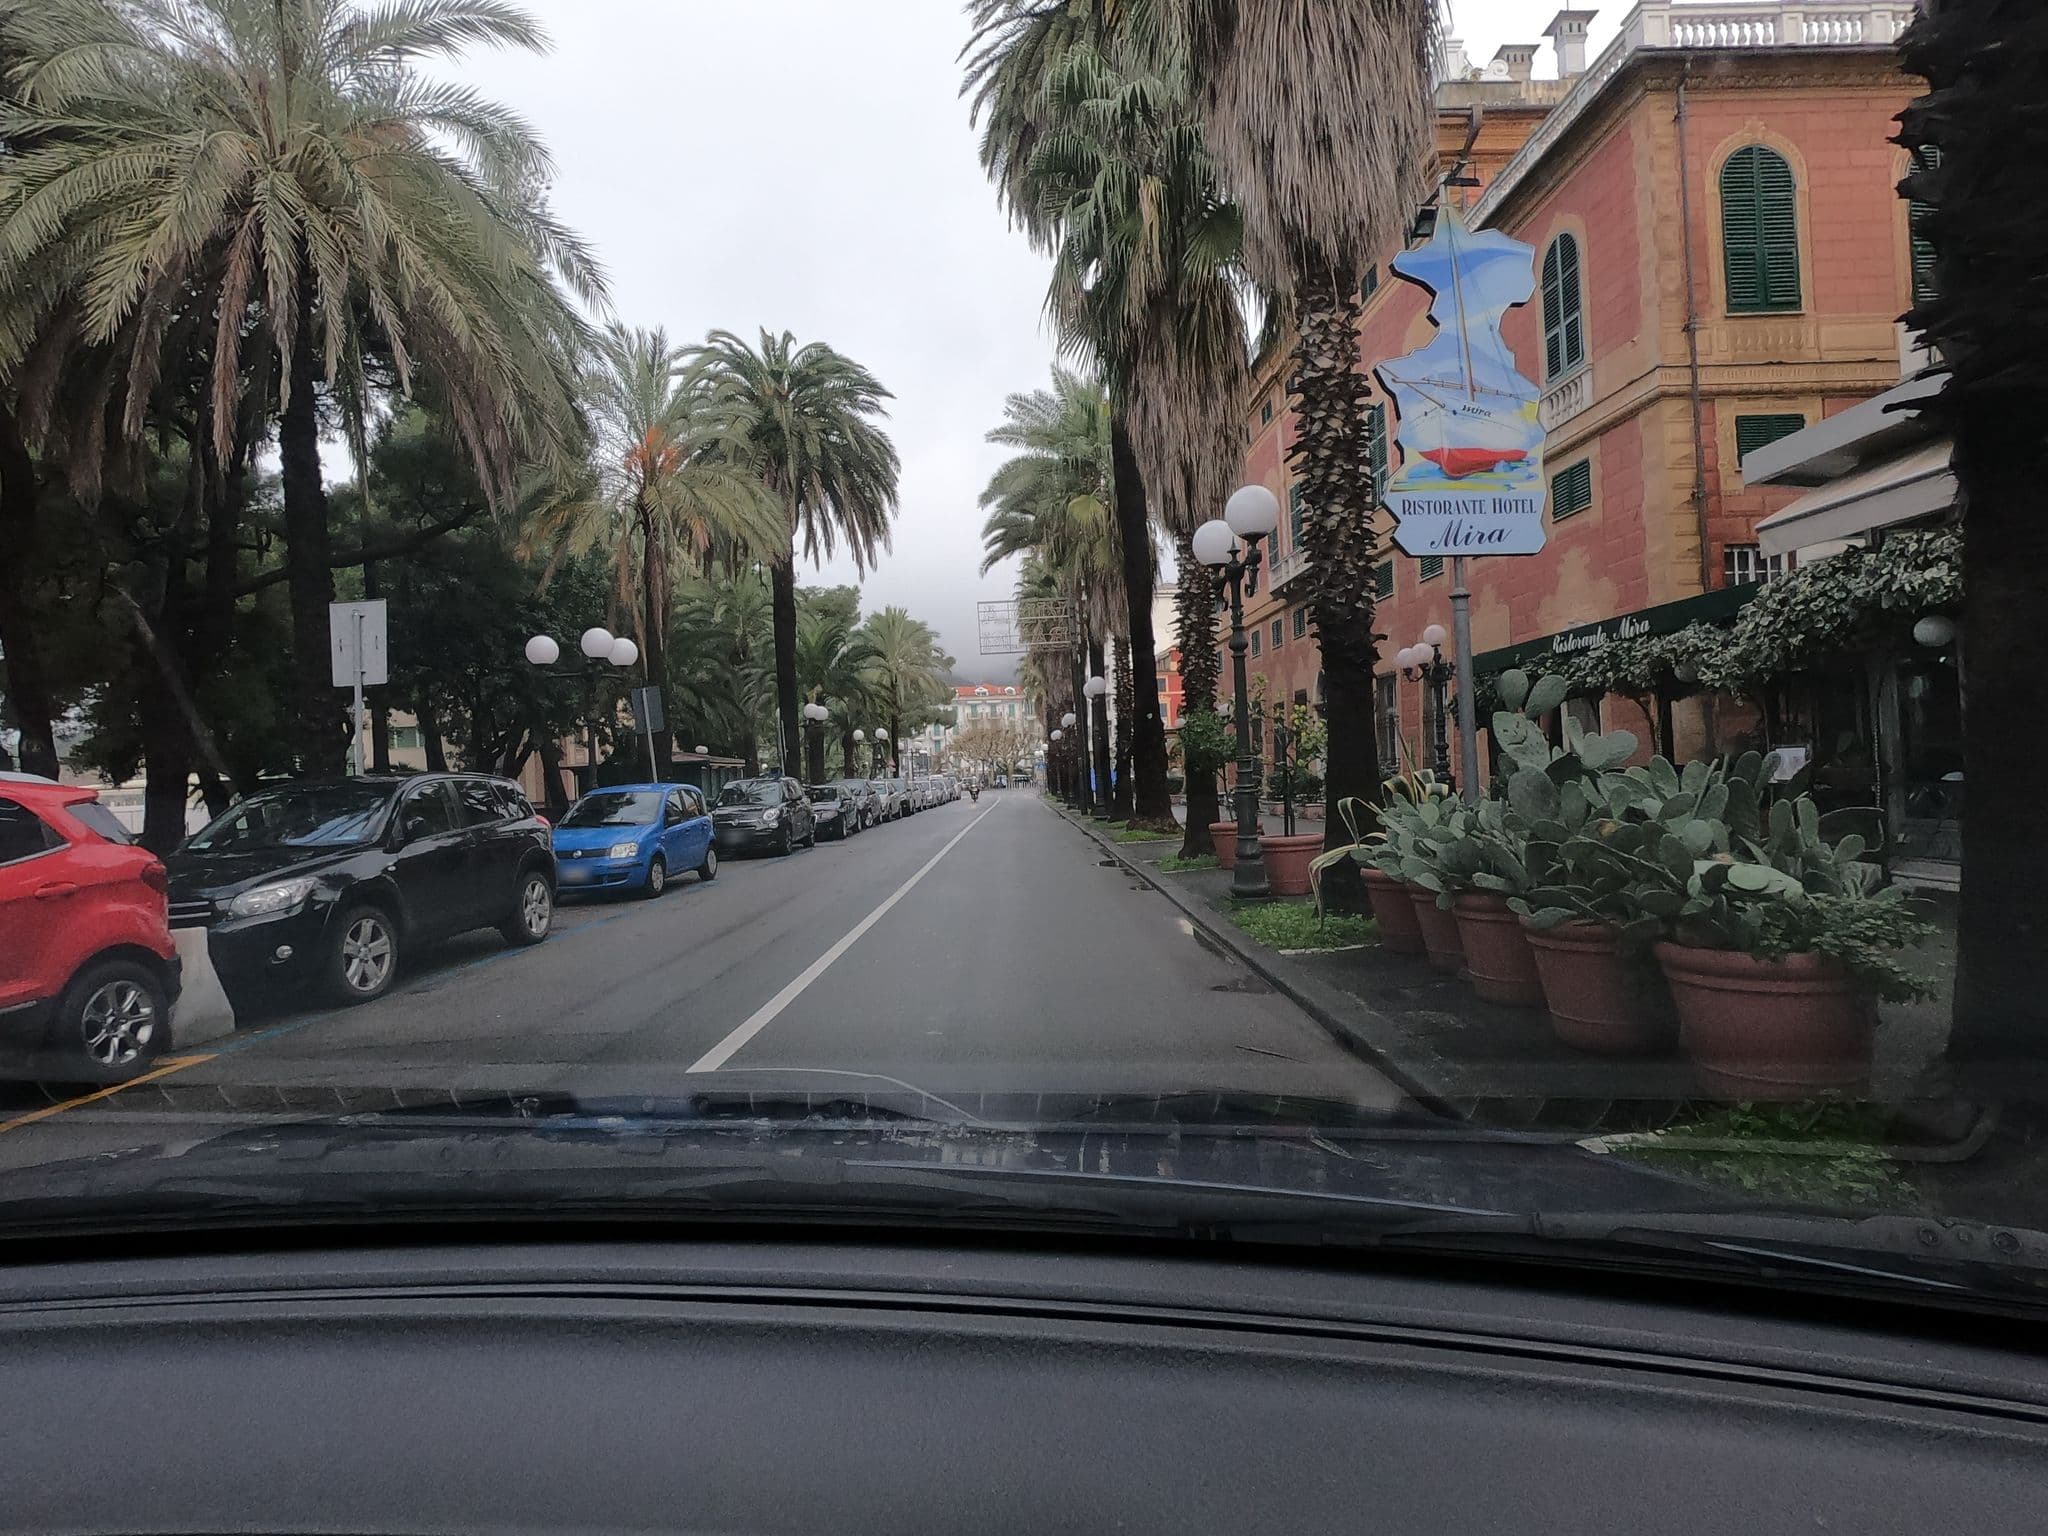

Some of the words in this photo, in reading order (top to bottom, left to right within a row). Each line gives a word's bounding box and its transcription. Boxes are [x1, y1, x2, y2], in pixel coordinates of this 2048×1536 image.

[1402, 498, 1487, 516] RISTORANTE
[1492, 497, 1537, 515] HOTEL
[1430, 518, 1512, 550] Mira
[1552, 625, 1608, 654] Ristorante
[1613, 615, 1651, 640] Mira
